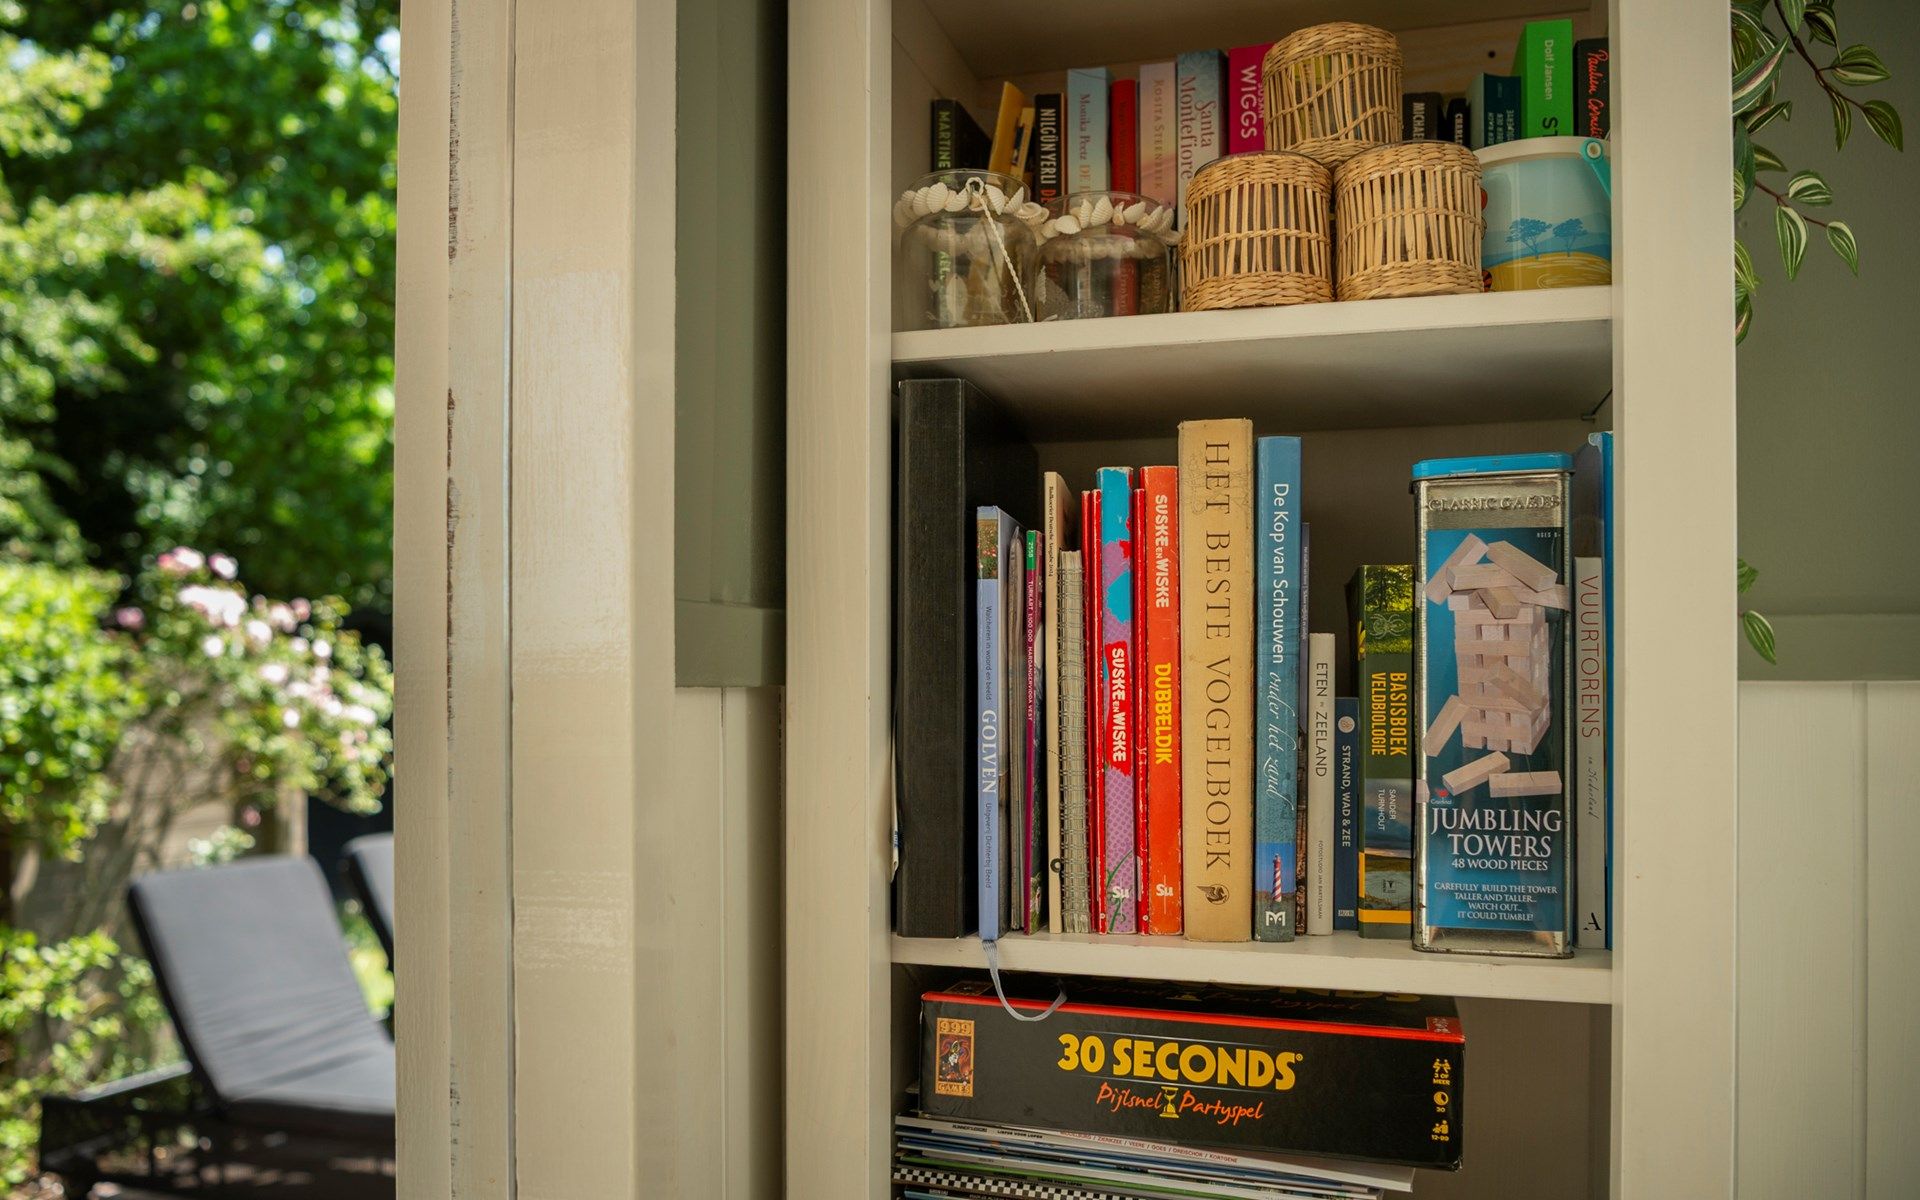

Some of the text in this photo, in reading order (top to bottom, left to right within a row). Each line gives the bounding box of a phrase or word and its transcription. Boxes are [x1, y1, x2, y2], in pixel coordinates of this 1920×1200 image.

[1543, 39, 1555, 100] Dolf Jansen
[1586, 49, 1609, 95] Paulien
[1195, 101, 1217, 148] Santa
[1241, 65, 1257, 140] WIGGS
[939, 111, 953, 169] MARTINE
[1040, 109, 1057, 184] NILGÜN YERLI
[1079, 93, 1091, 161] Monika Peetz
[1180, 76, 1197, 180] Montefiore
[1155, 494, 1169, 547] SUSKE
[1427, 496, 1497, 511] CLASSIC
[1155, 558, 1170, 608] WISKE
[1269, 483, 1289, 663] De Kop van Schouwen
[985, 606, 993, 641] Walcheren
[985, 650, 993, 670] woord
[985, 672, 992, 680] en
[1204, 441, 1231, 871] HET BESTE VOGELBOEK
[1580, 575, 1601, 738] VUURTORENS
[985, 681, 993, 700] beeld
[1316, 662, 1328, 697] ETEN
[1112, 647, 1126, 762] SUSKE EN WISKE
[1154, 662, 1172, 764] DUBBELDIK
[1371, 672, 1387, 756] VELDBIOLOGIE
[1389, 672, 1407, 756] BASISBOEK
[982, 709, 997, 794] GOLVEN
[1262, 672, 1297, 811] onder het zand
[1314, 711, 1328, 778] ZEELAND
[1340, 745, 1351, 847] STRAND, WAD & ZEE
[1377, 789, 1386, 831] TURNHOUT
[1388, 788, 1396, 820] SANDER
[1430, 807, 1562, 835] JUMBLING
[983, 802, 992, 889] Uitgeverij Dichterbij Beeld
[1447, 833, 1551, 858] TOWERS
[1451, 858, 1549, 871] 48 WOOD PIECES
[1155, 883, 1174, 897] Su
[1434, 881, 1557, 894] CAREFULLY BUILD THE TOWER
[1453, 892, 1483, 900] TALLER
[1483, 893, 1503, 901] AND
[1468, 902, 1498, 910] WATCH
[1466, 911, 1497, 919] COULD
[1499, 912, 1534, 921] TUMBLE!
[940, 1020, 972, 1035] 999
[1057, 1033, 1106, 1073] 30
[938, 1083, 971, 1095] GAMES
[1096, 1081, 1263, 1125] Pijlsnel Partyspel
